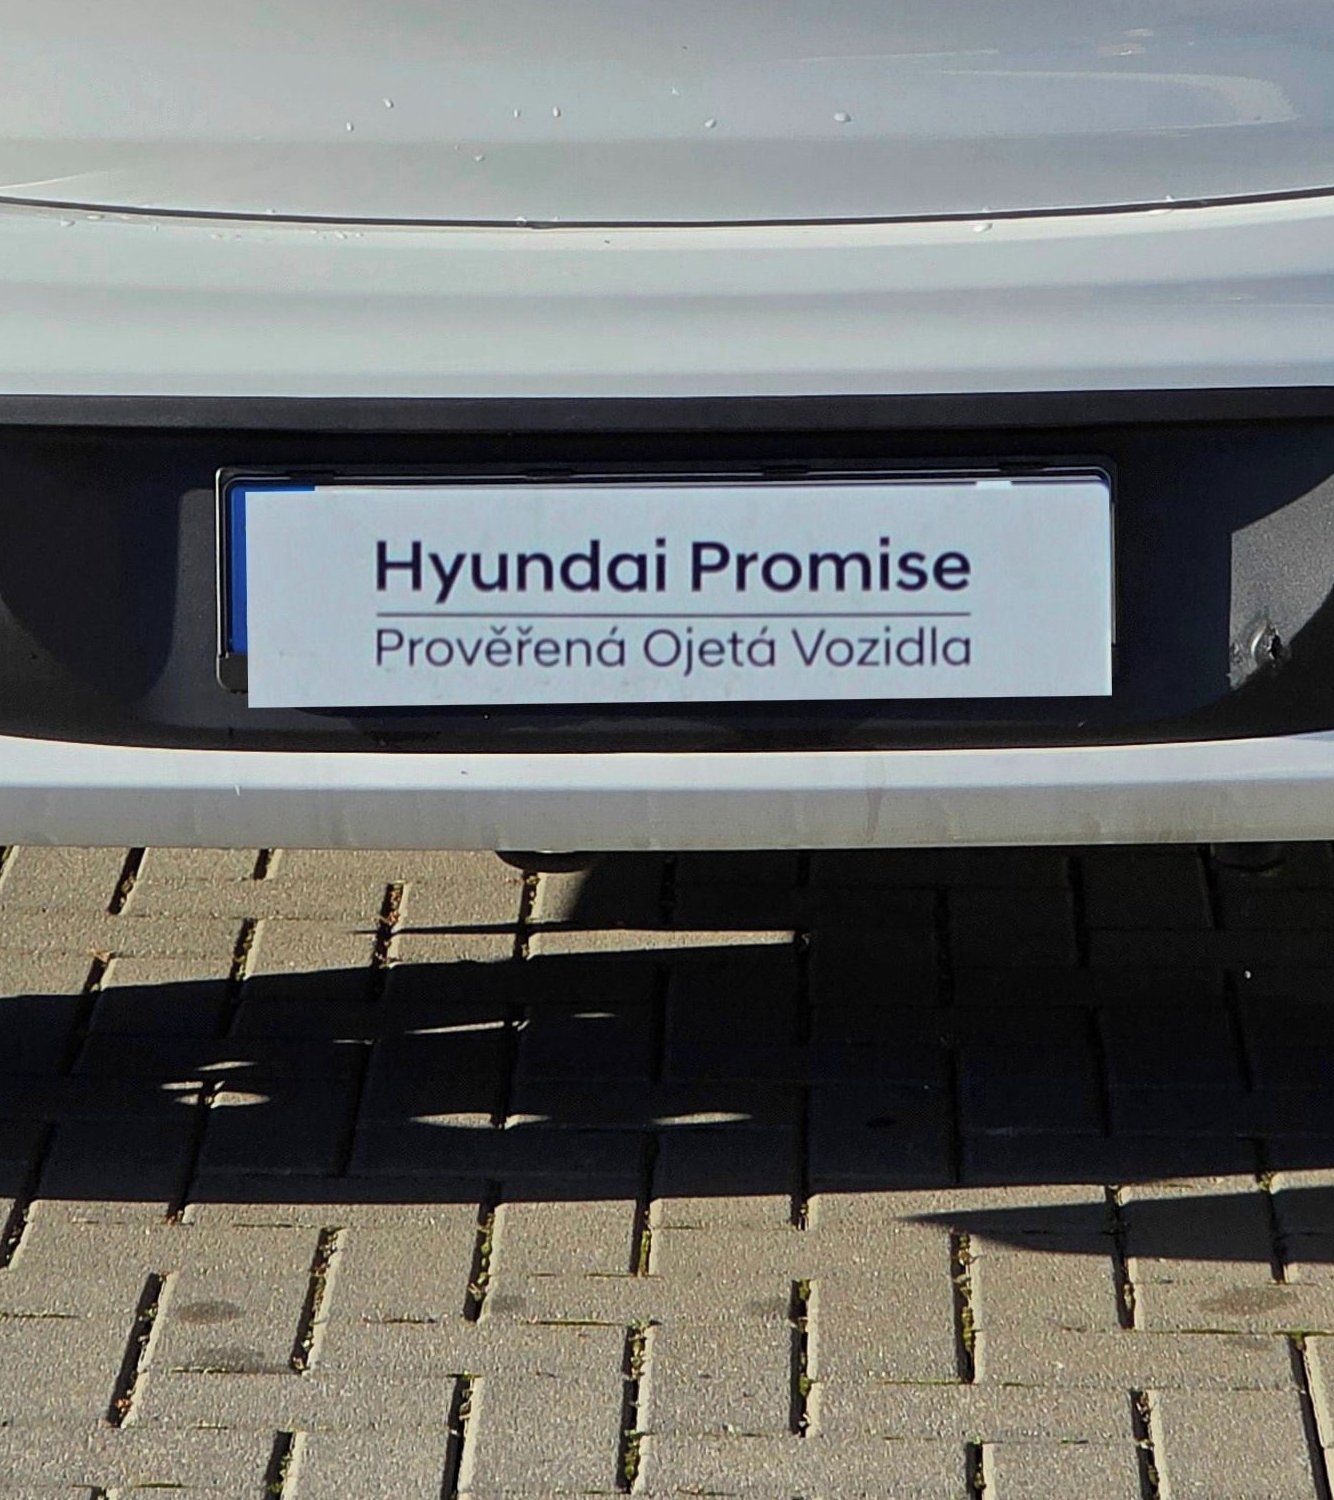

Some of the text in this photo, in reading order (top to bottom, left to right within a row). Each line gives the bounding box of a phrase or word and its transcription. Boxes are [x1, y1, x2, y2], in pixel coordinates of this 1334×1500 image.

[376, 536, 971, 605] Hyundai Promise
[376, 625, 971, 677] Prověřená Ojetá Vozidla
